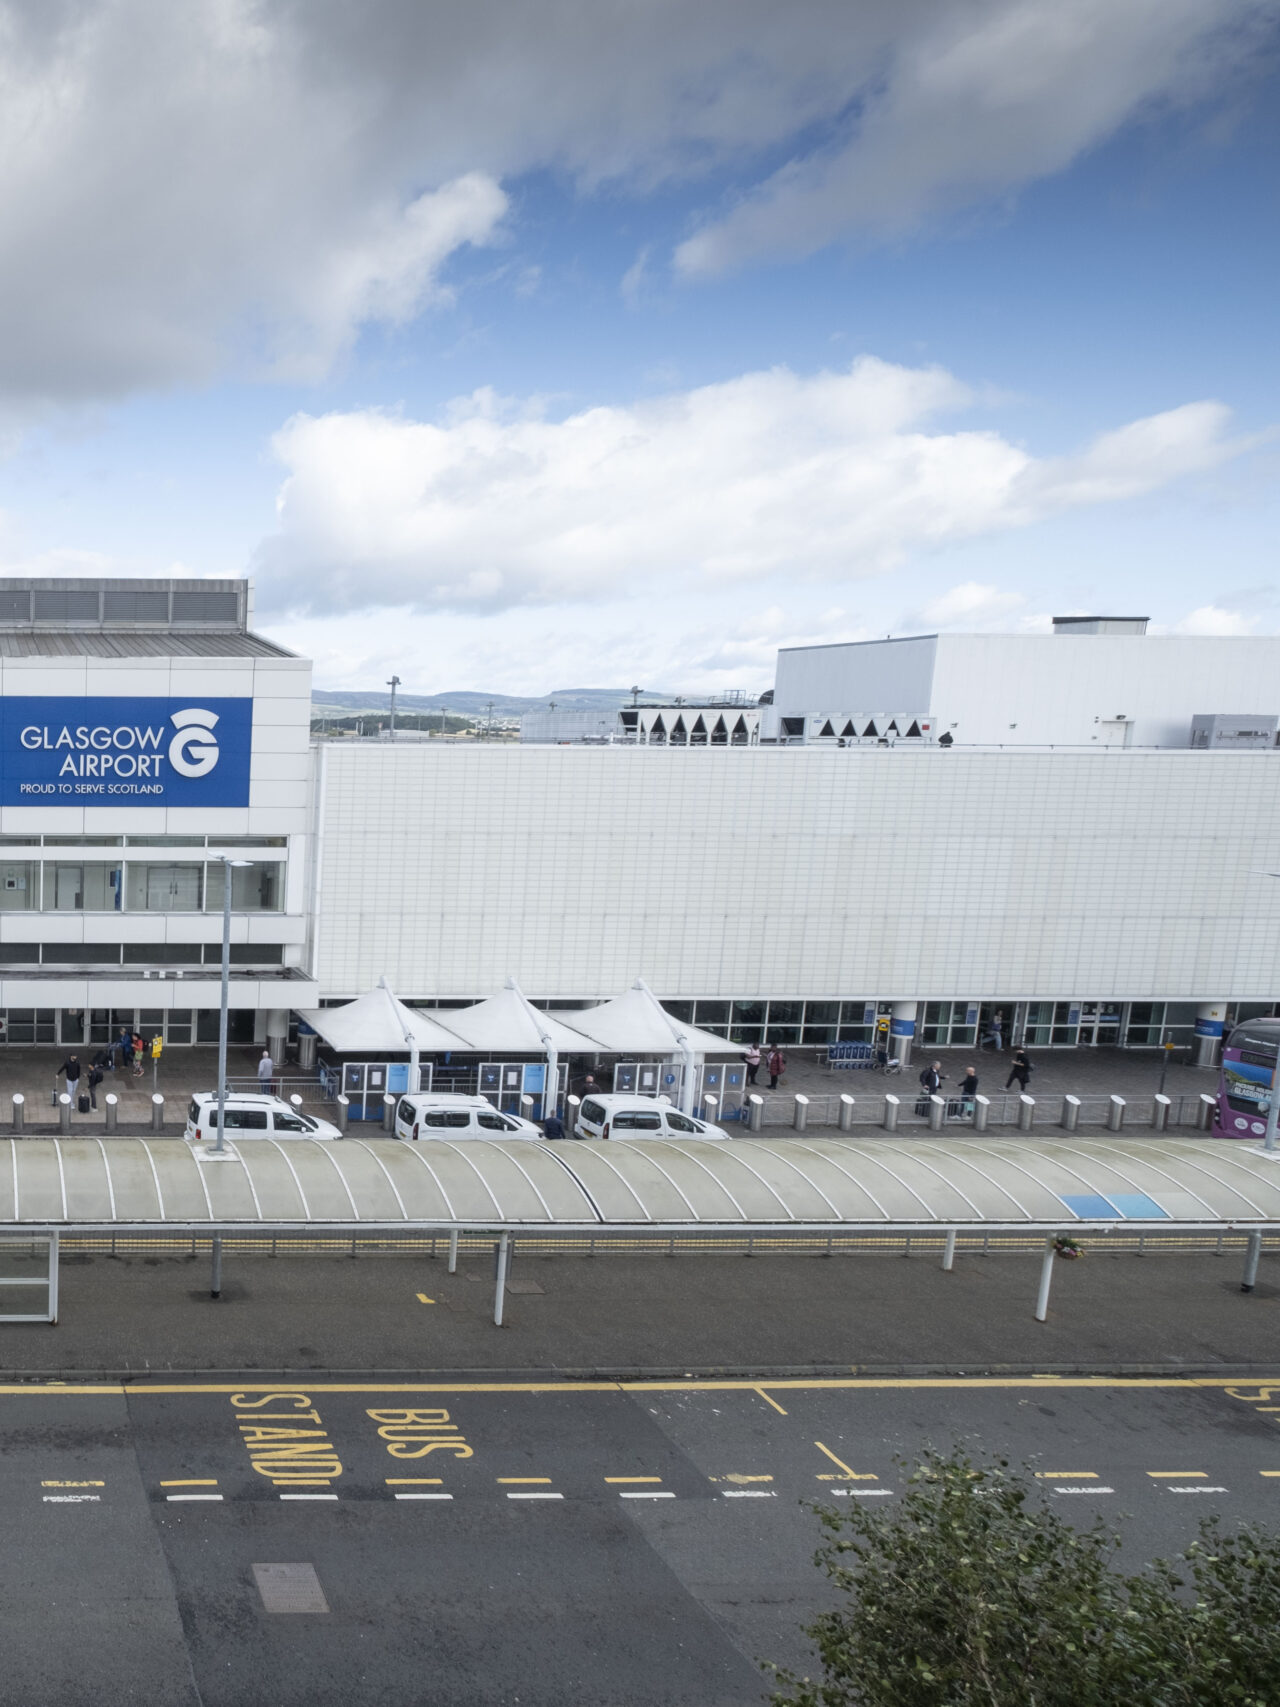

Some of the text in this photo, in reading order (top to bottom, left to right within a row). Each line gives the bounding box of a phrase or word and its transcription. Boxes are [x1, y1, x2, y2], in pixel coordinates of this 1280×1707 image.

[20, 726, 165, 750] GLASGOW
[58, 753, 165, 777] AIRPORT
[20, 783, 164, 795] PROUD TO SERVE SCOTLAND
[230, 1393, 343, 1480] STAND
[365, 1408, 474, 1459] BUS
